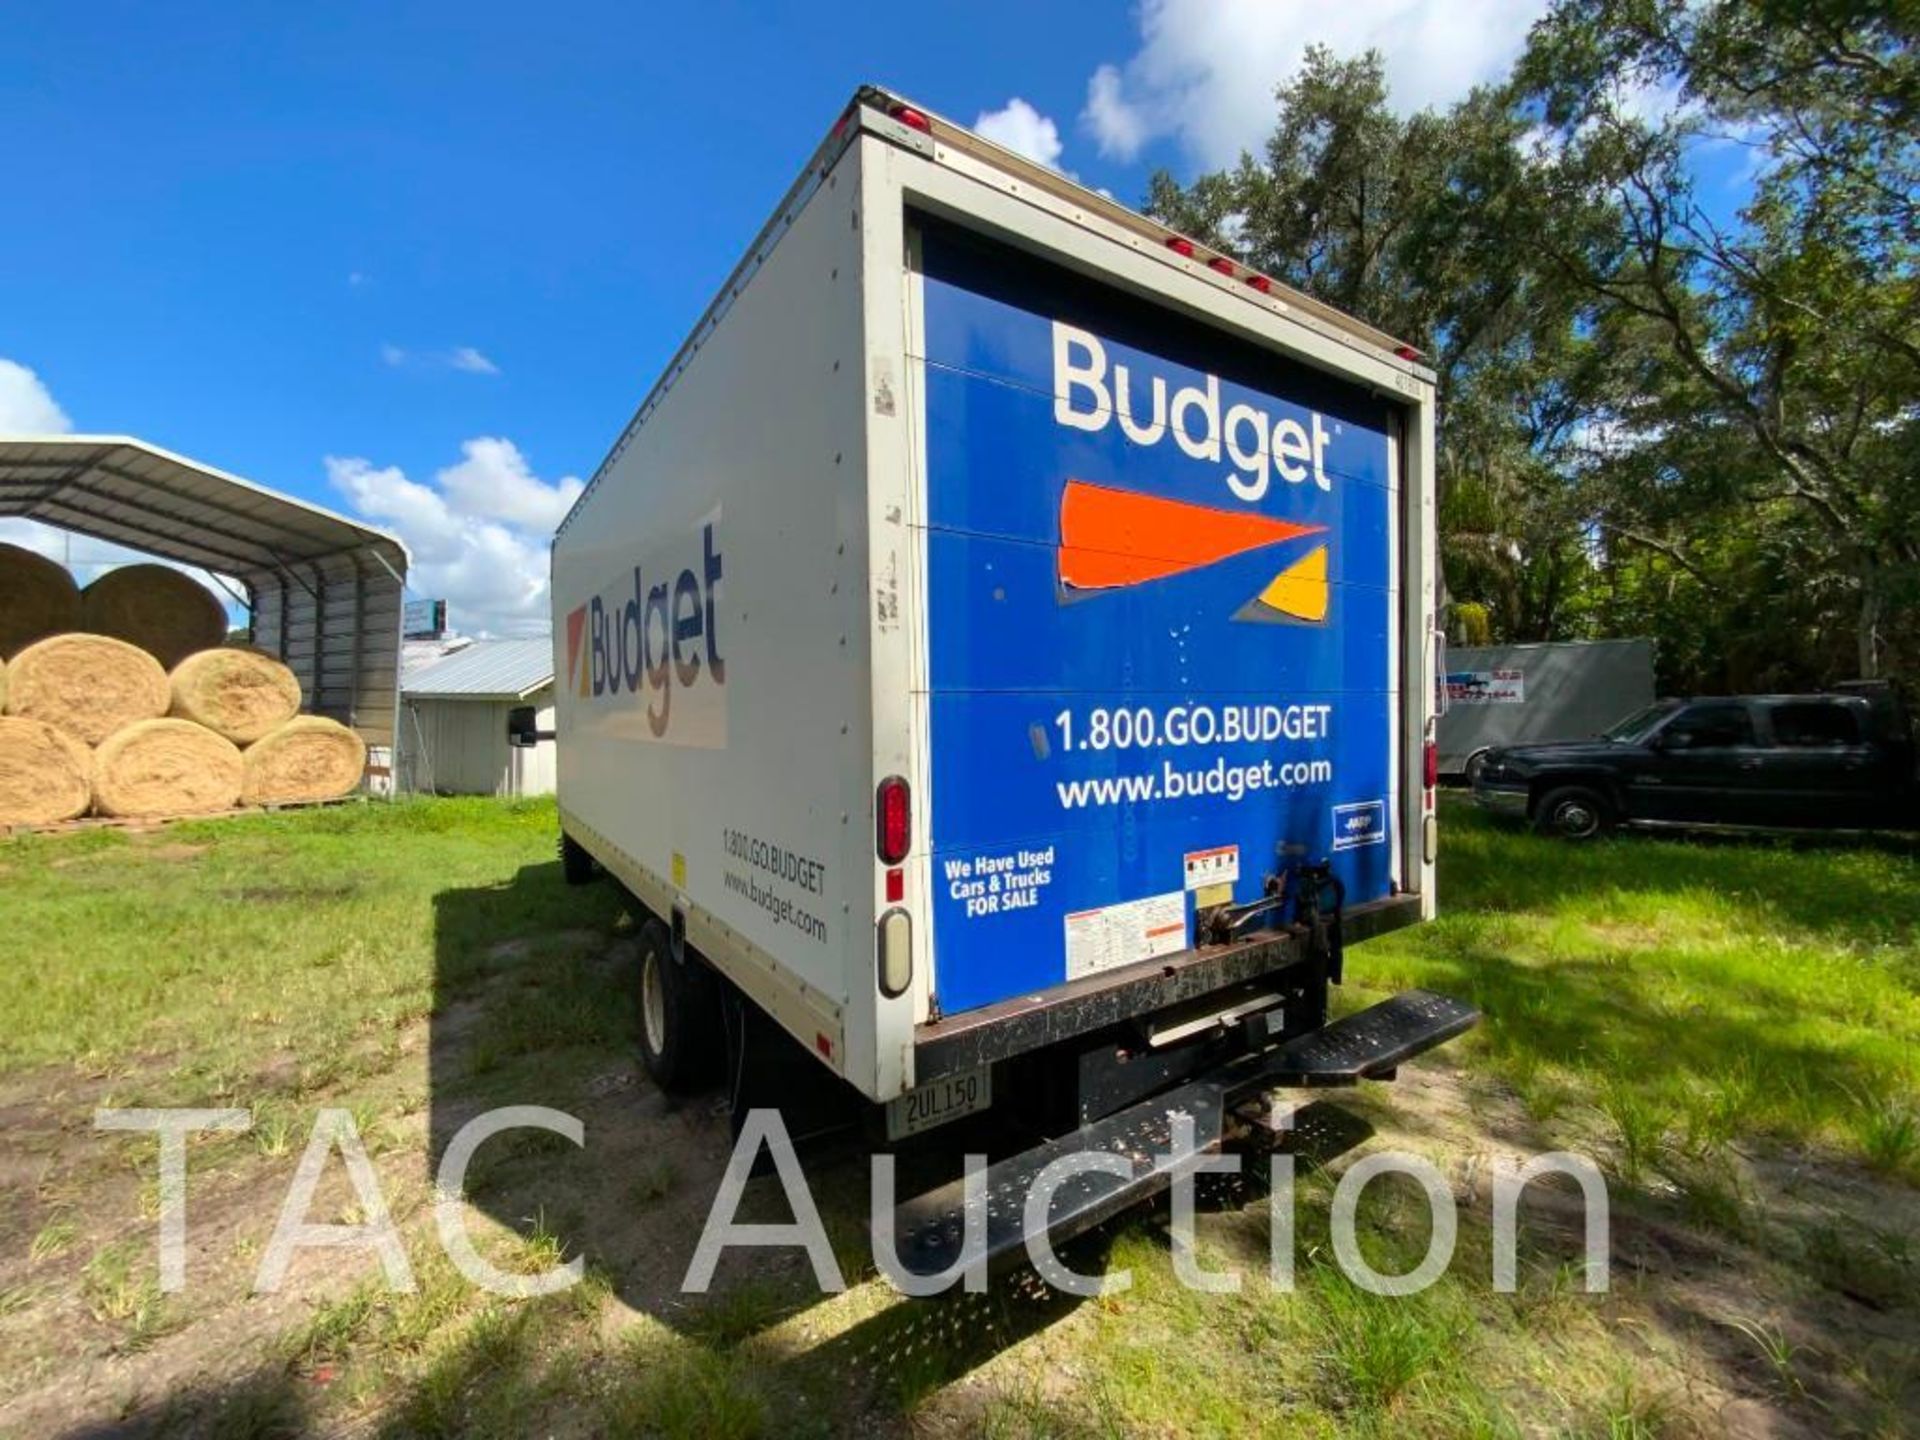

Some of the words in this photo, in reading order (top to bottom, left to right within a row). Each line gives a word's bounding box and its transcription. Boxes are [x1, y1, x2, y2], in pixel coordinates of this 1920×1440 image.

[1052, 319, 1331, 502] Budget
[591, 524, 726, 738] Budget
[1055, 705, 1331, 751] 1.800.GO.BUDGET
[1056, 756, 1332, 809] www.budget.com
[944, 859, 972, 881] We
[975, 855, 1015, 876] Have
[1018, 845, 1054, 868] Used
[950, 880, 986, 900] Cars
[988, 873, 1001, 894] &
[1003, 867, 1051, 890] Trucks
[723, 871, 827, 944] www.budget.com
[966, 894, 999, 918] FOR
[1001, 887, 1038, 911] SALE
